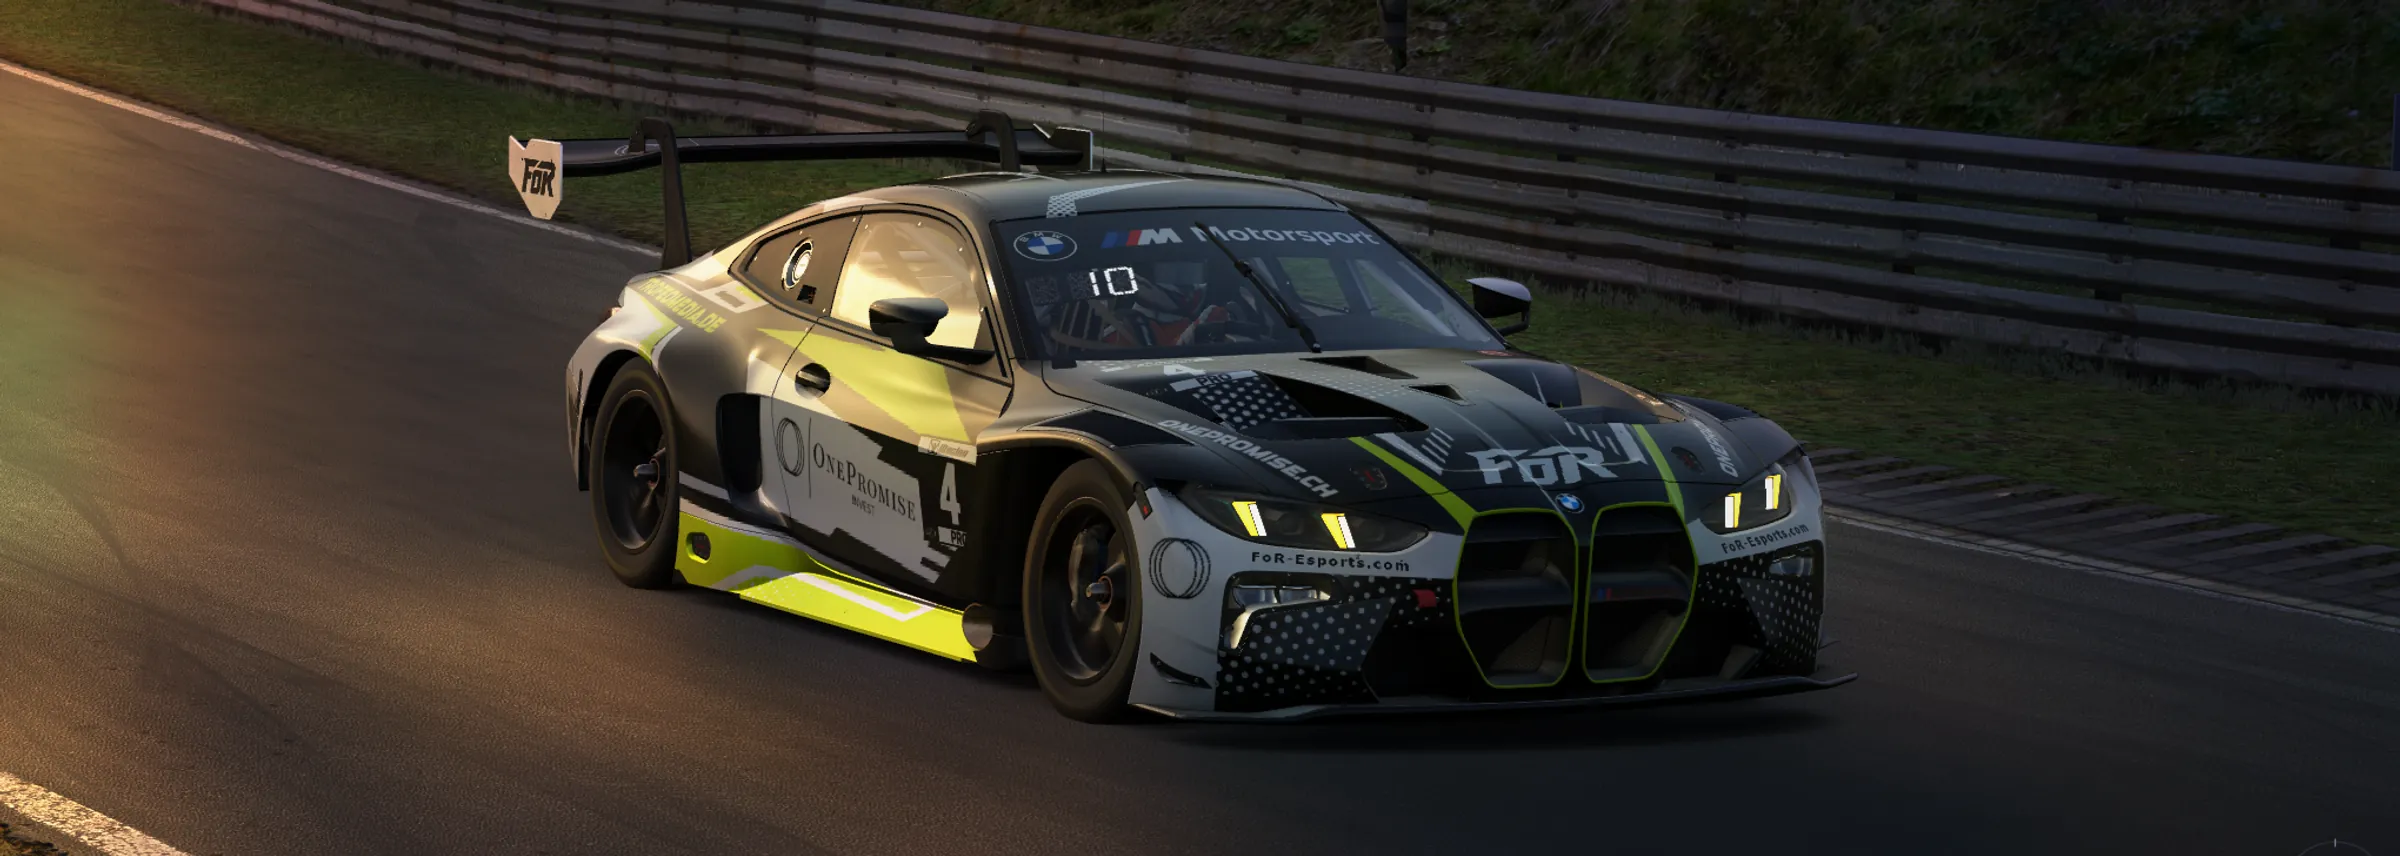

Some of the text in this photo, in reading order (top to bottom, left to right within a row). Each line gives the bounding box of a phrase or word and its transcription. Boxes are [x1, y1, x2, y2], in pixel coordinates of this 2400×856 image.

[1189, 226, 1380, 246] Motorsport
[1089, 266, 1139, 296] 10
[1196, 373, 1232, 386] PRO
[1157, 419, 1339, 498] ONEPROMISE.CH
[851, 495, 875, 517] INVEST
[940, 462, 961, 525] 4
[1721, 523, 1809, 554] FoR-Esports.com
[1251, 551, 1410, 572] FoR-Esports.com
